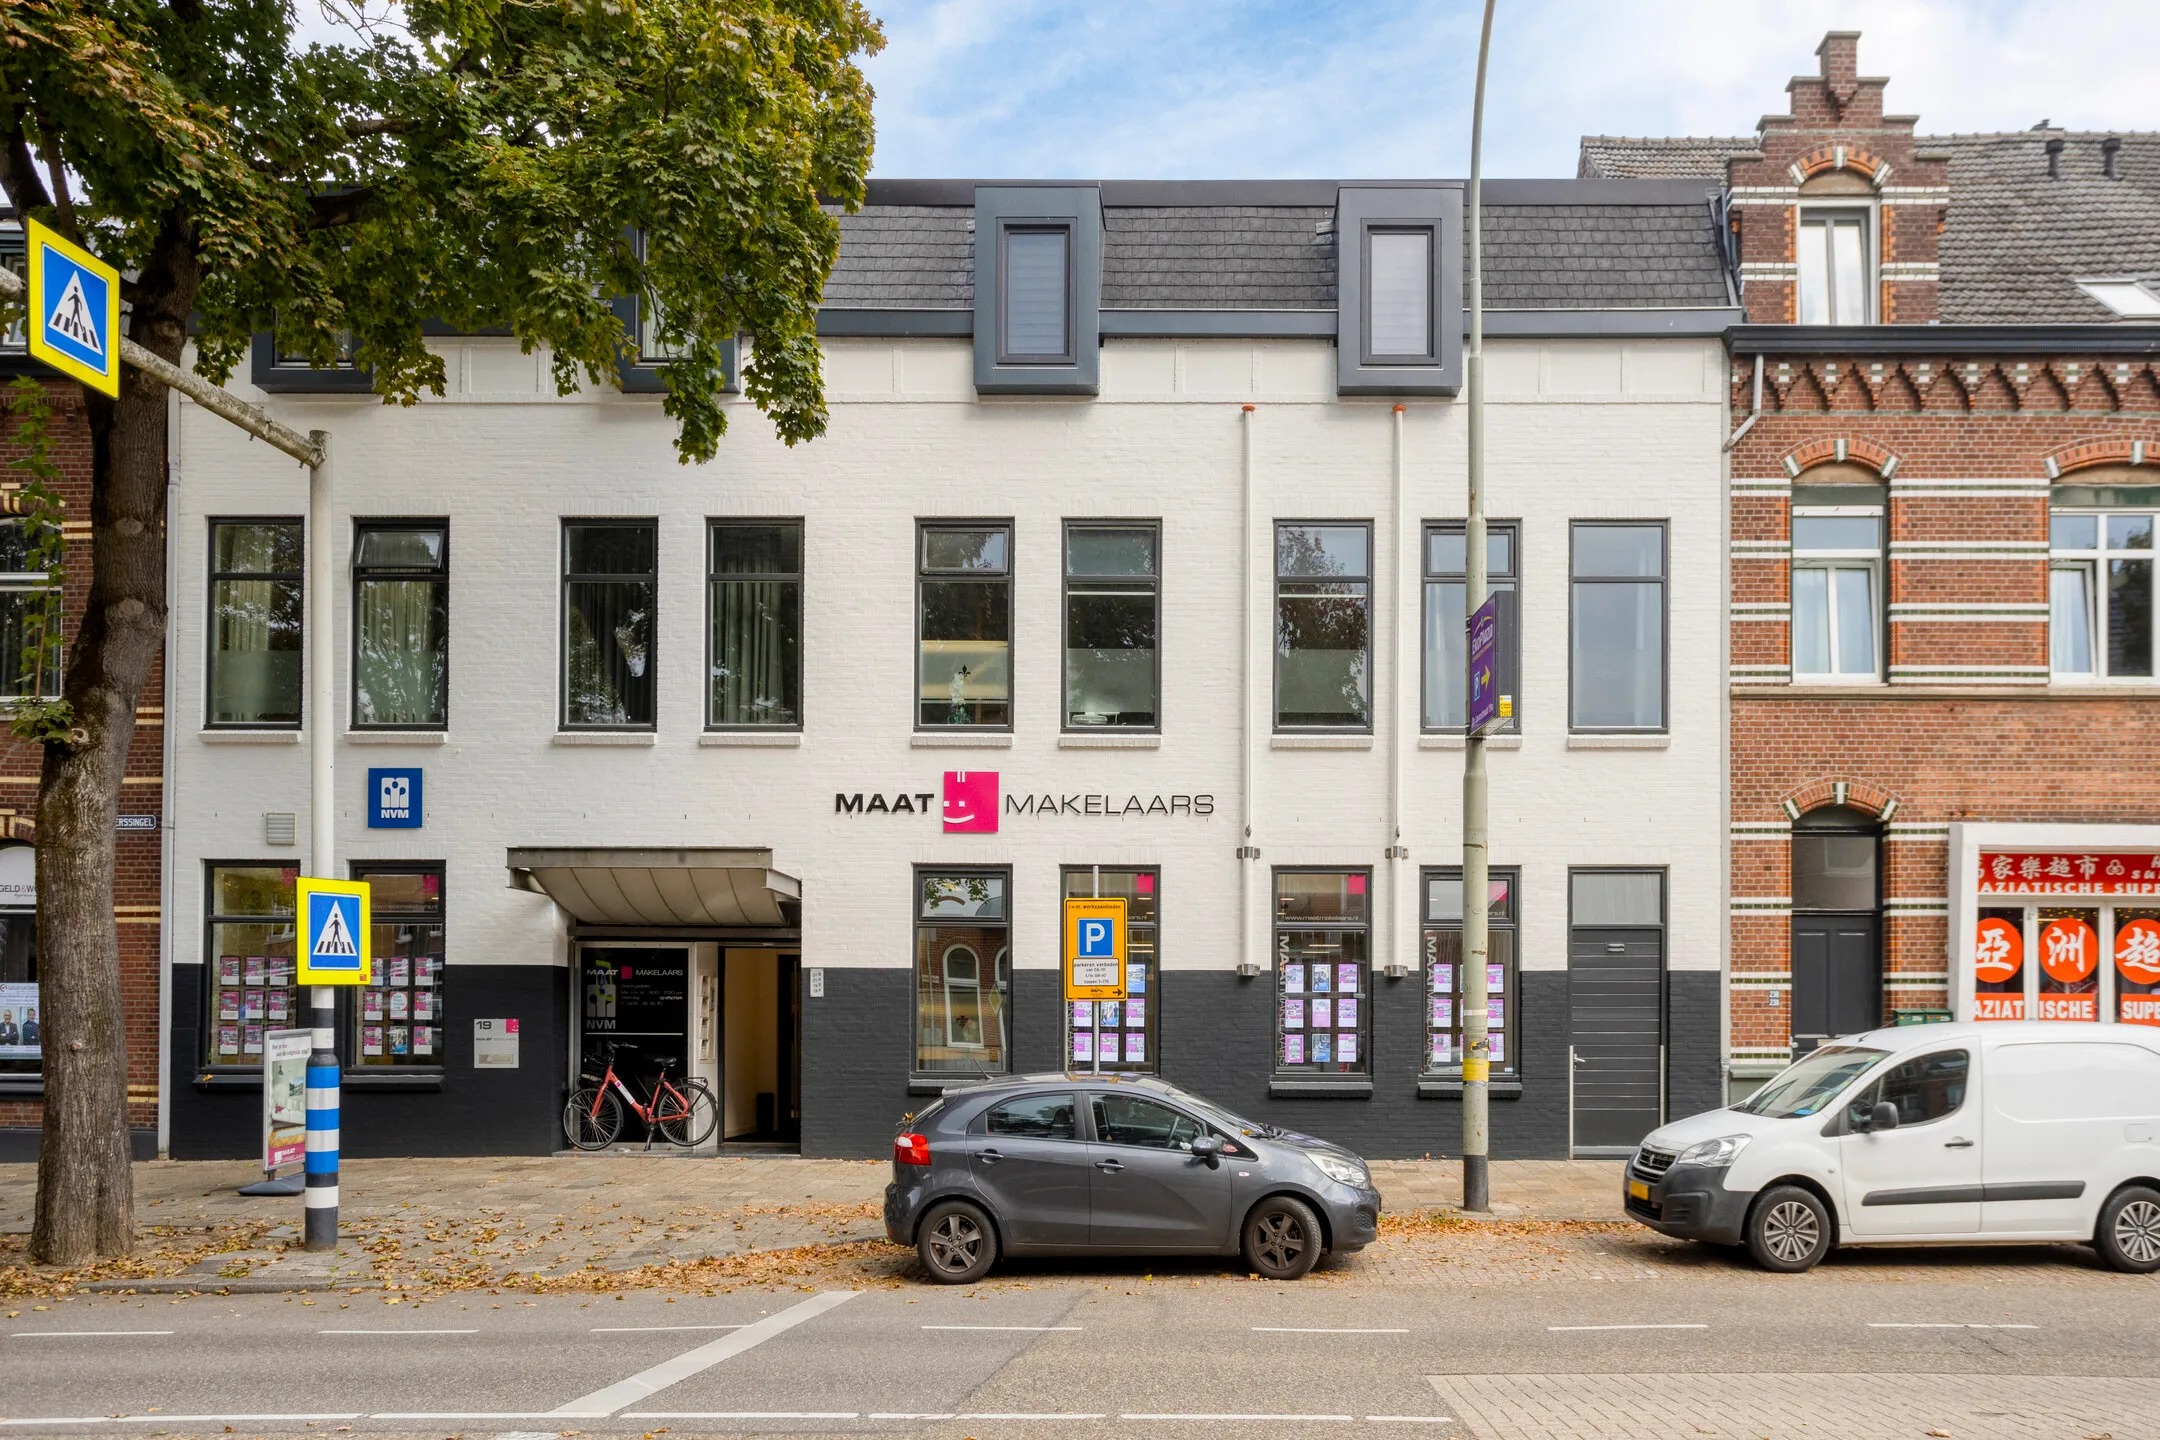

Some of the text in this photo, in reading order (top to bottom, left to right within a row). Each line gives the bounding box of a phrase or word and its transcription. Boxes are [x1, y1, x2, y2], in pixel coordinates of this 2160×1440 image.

[835, 793, 1215, 816] MAAT MAKELAARS
[381, 809, 409, 819] NVM
[1980, 882, 2104, 894] AZIATISCHE
[1086, 923, 1106, 953] P
[476, 1020, 492, 1030] 19
[587, 1020, 616, 1030] NVM
